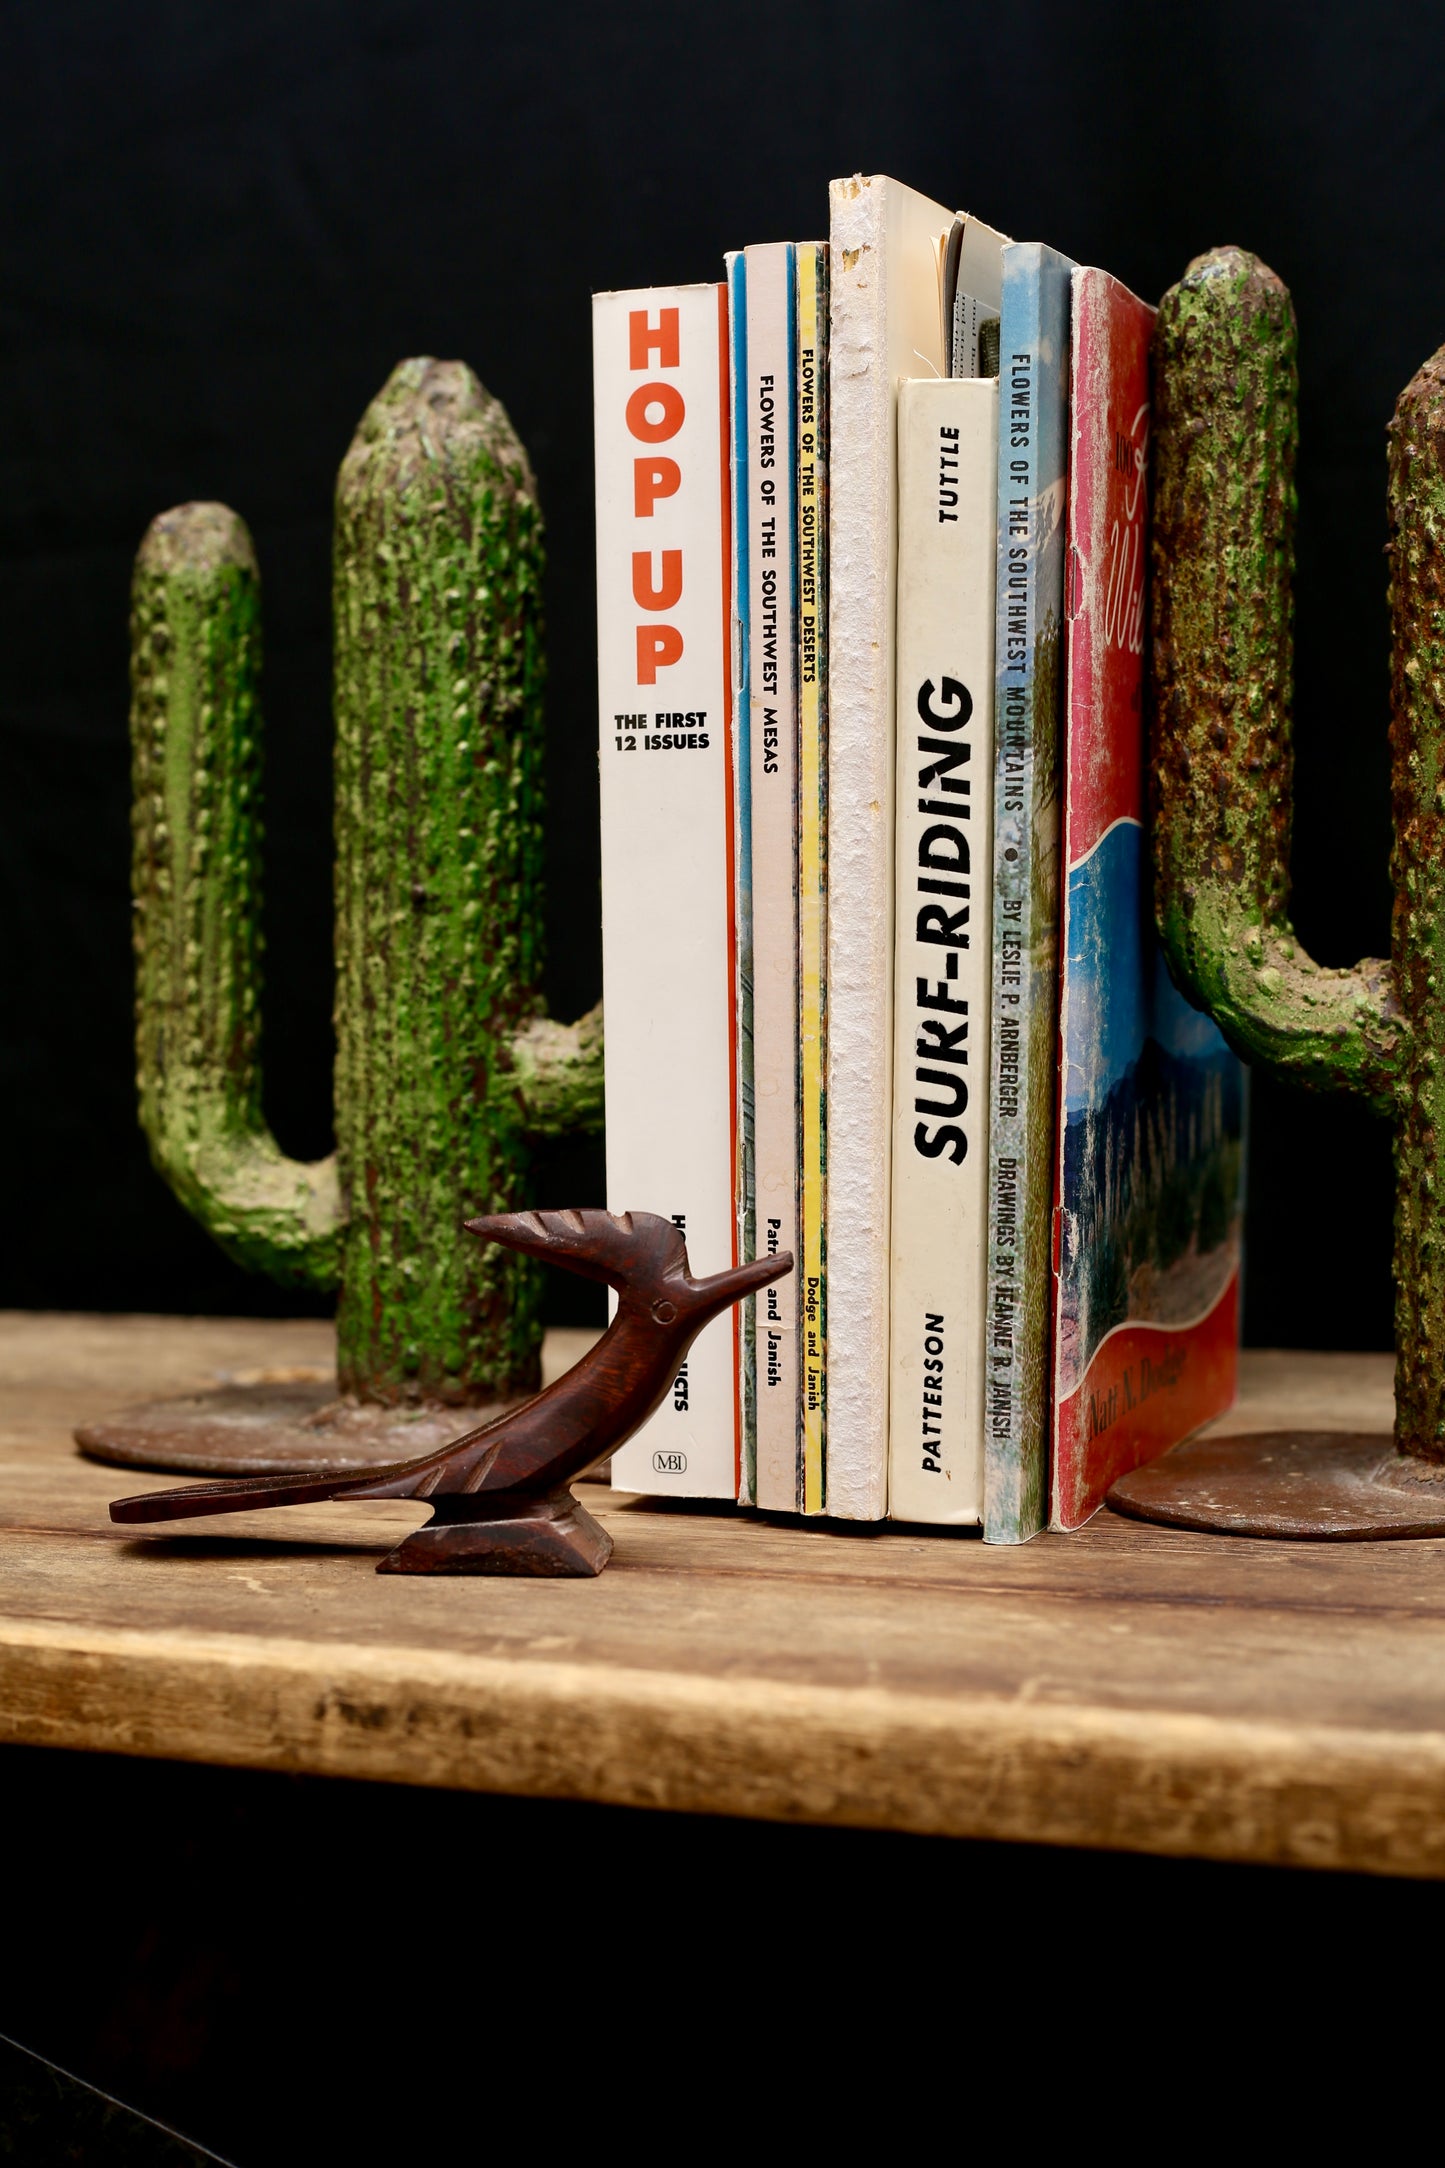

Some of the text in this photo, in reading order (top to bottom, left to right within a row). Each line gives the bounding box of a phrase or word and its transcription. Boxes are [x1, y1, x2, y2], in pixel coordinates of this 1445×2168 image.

[626, 308, 686, 685] HOP UP
[802, 349, 816, 683] FLOWERS OF THE SOUTHWEST DESERTS
[938, 426, 960, 524] TUTTLE
[760, 376, 779, 774] FLOWERS OF THE SOUTHWEST MESAS
[614, 712, 707, 730] THE FIRST
[615, 733, 710, 751] 12 ISSUES
[914, 677, 975, 1167] SURF-RIDING
[992, 354, 1031, 1439] FLOWERS OF THE SOUTHWEST MOUNTAINS BY LESLIE P. ARNBERGER DRAWINGS BY JEANNE R. JANISH
[767, 1218, 783, 1387] Patr and Janish
[805, 1277, 821, 1411] Dodge and Janish
[657, 1454, 682, 1471] MBI
[922, 1312, 945, 1474] PATTERSON
[1088, 1386, 1118, 1442] Natt
